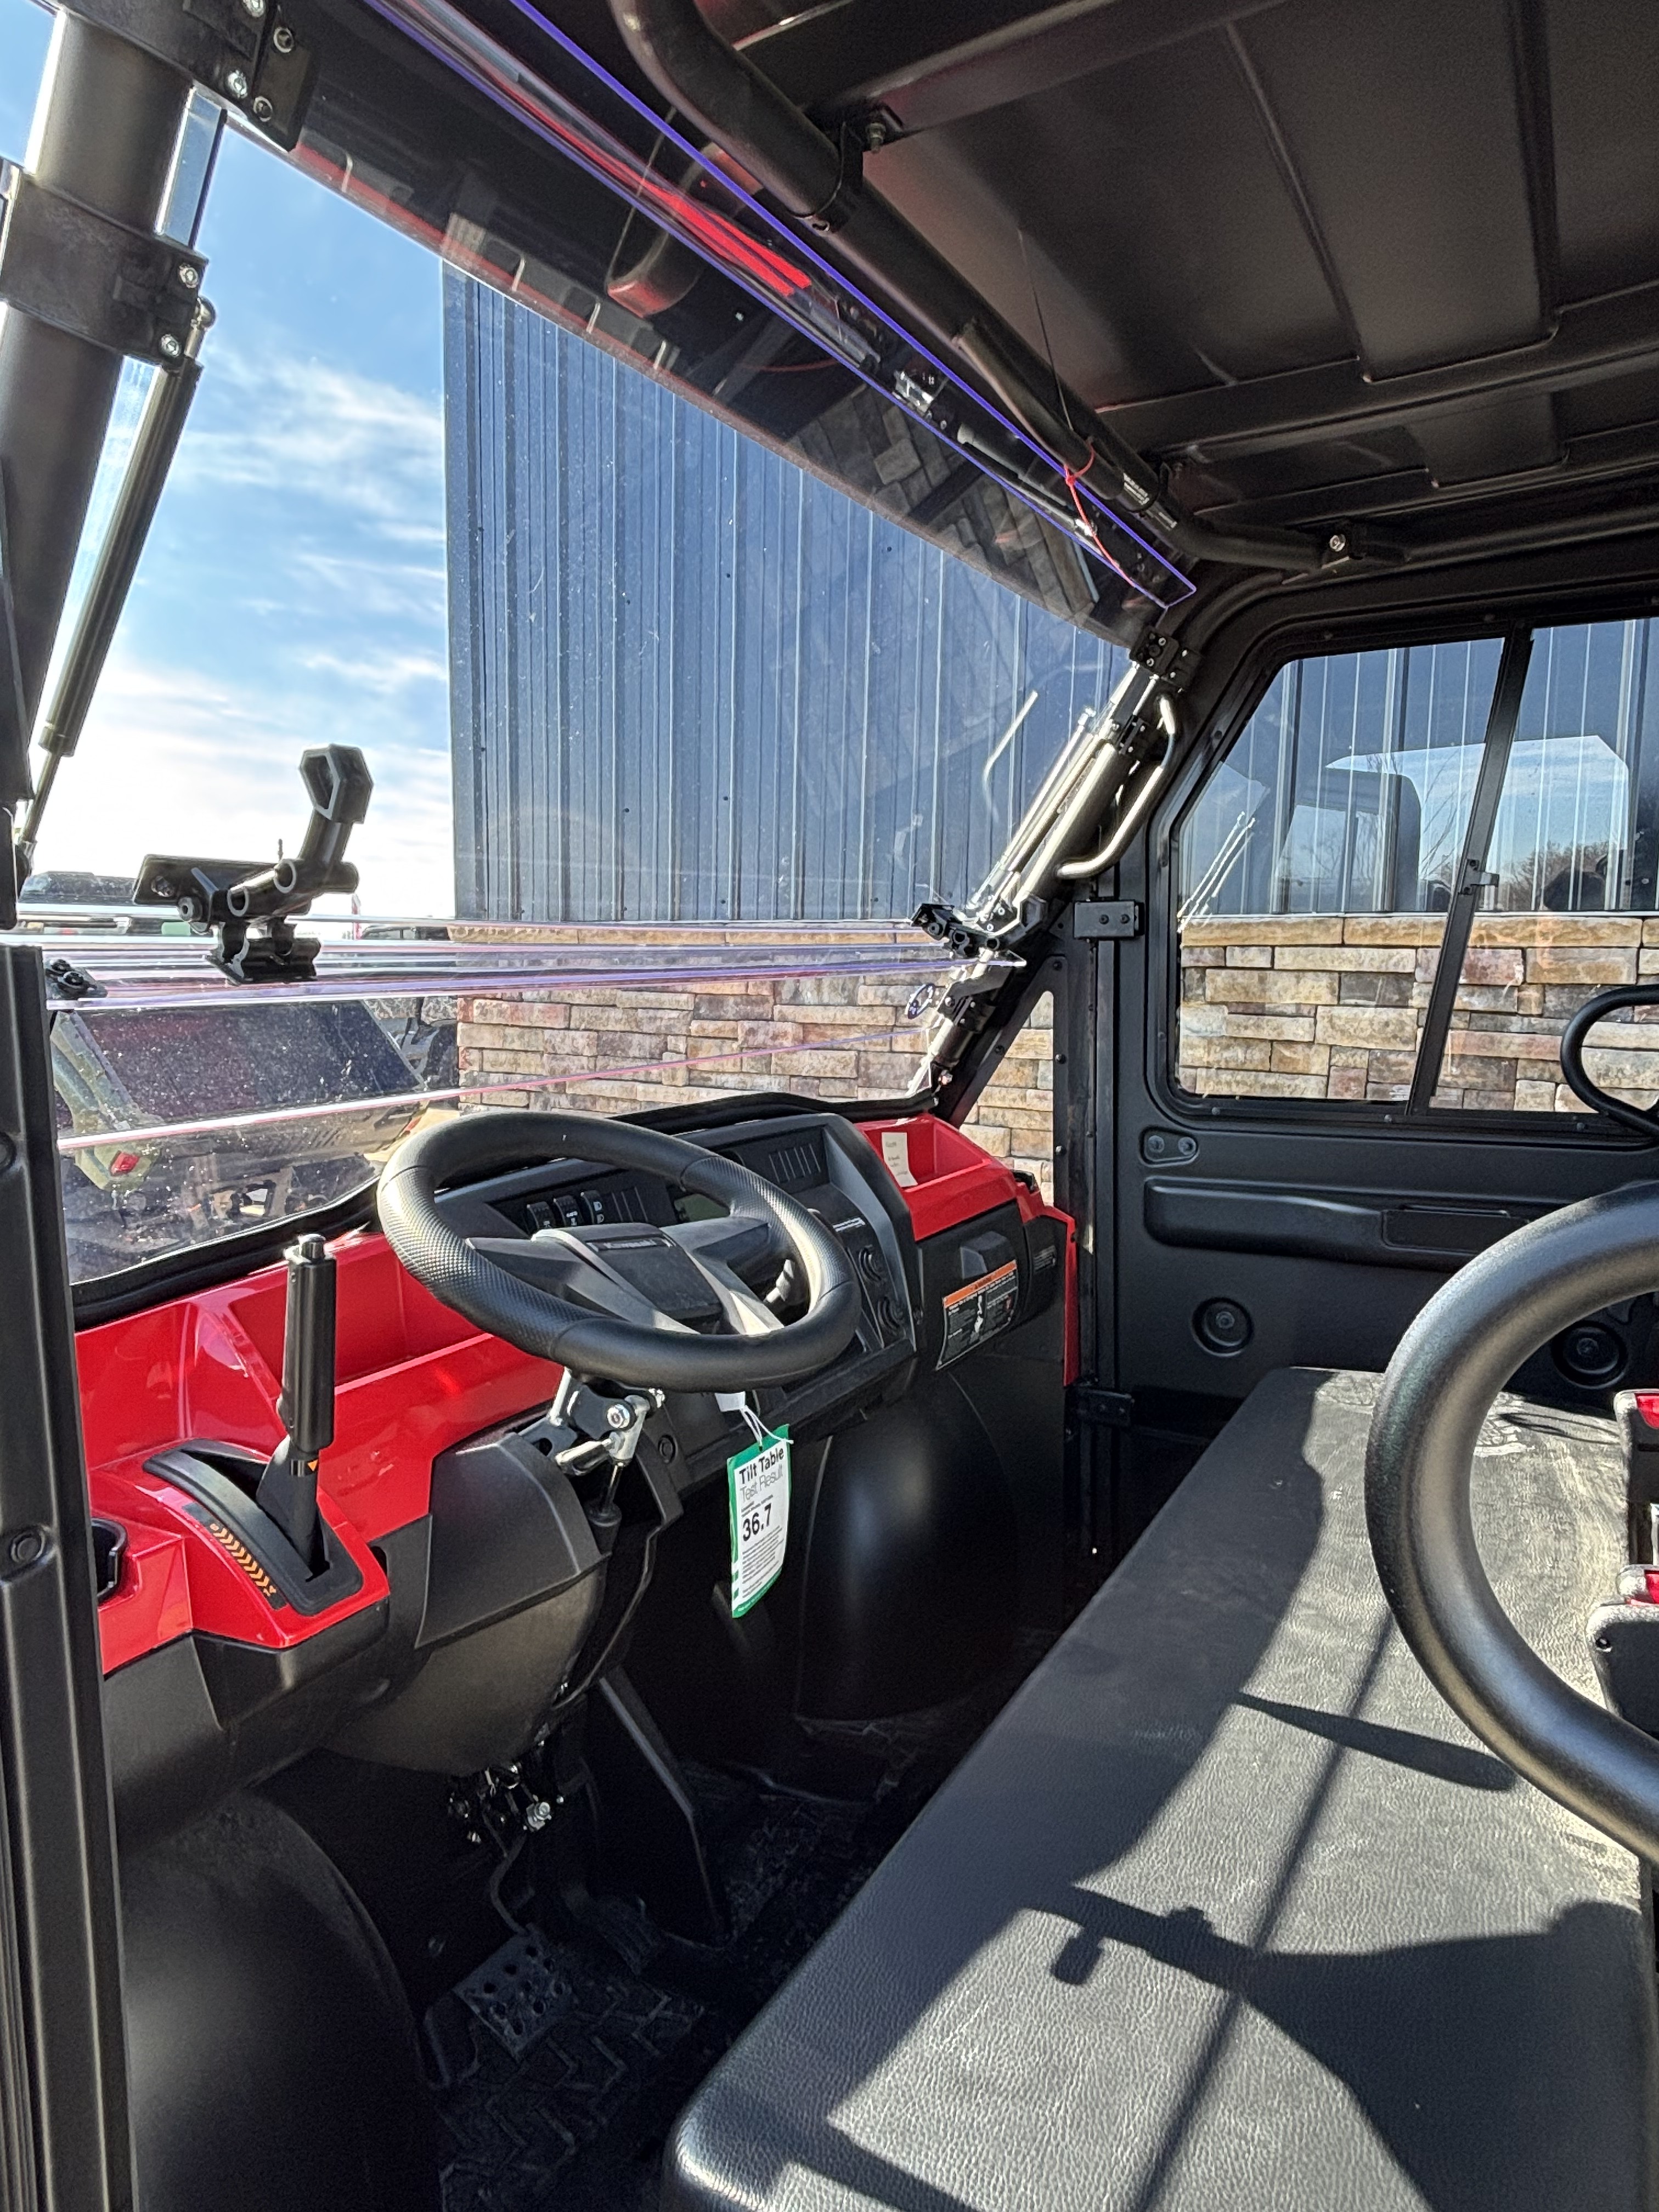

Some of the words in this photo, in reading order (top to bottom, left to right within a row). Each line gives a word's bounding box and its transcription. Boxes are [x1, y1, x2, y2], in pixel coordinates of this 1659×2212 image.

[739, 1463, 757, 1484] Tilt
[758, 1448, 784, 1472] Table
[740, 1482, 758, 1502] Test
[743, 1503, 771, 1542] 36.7
